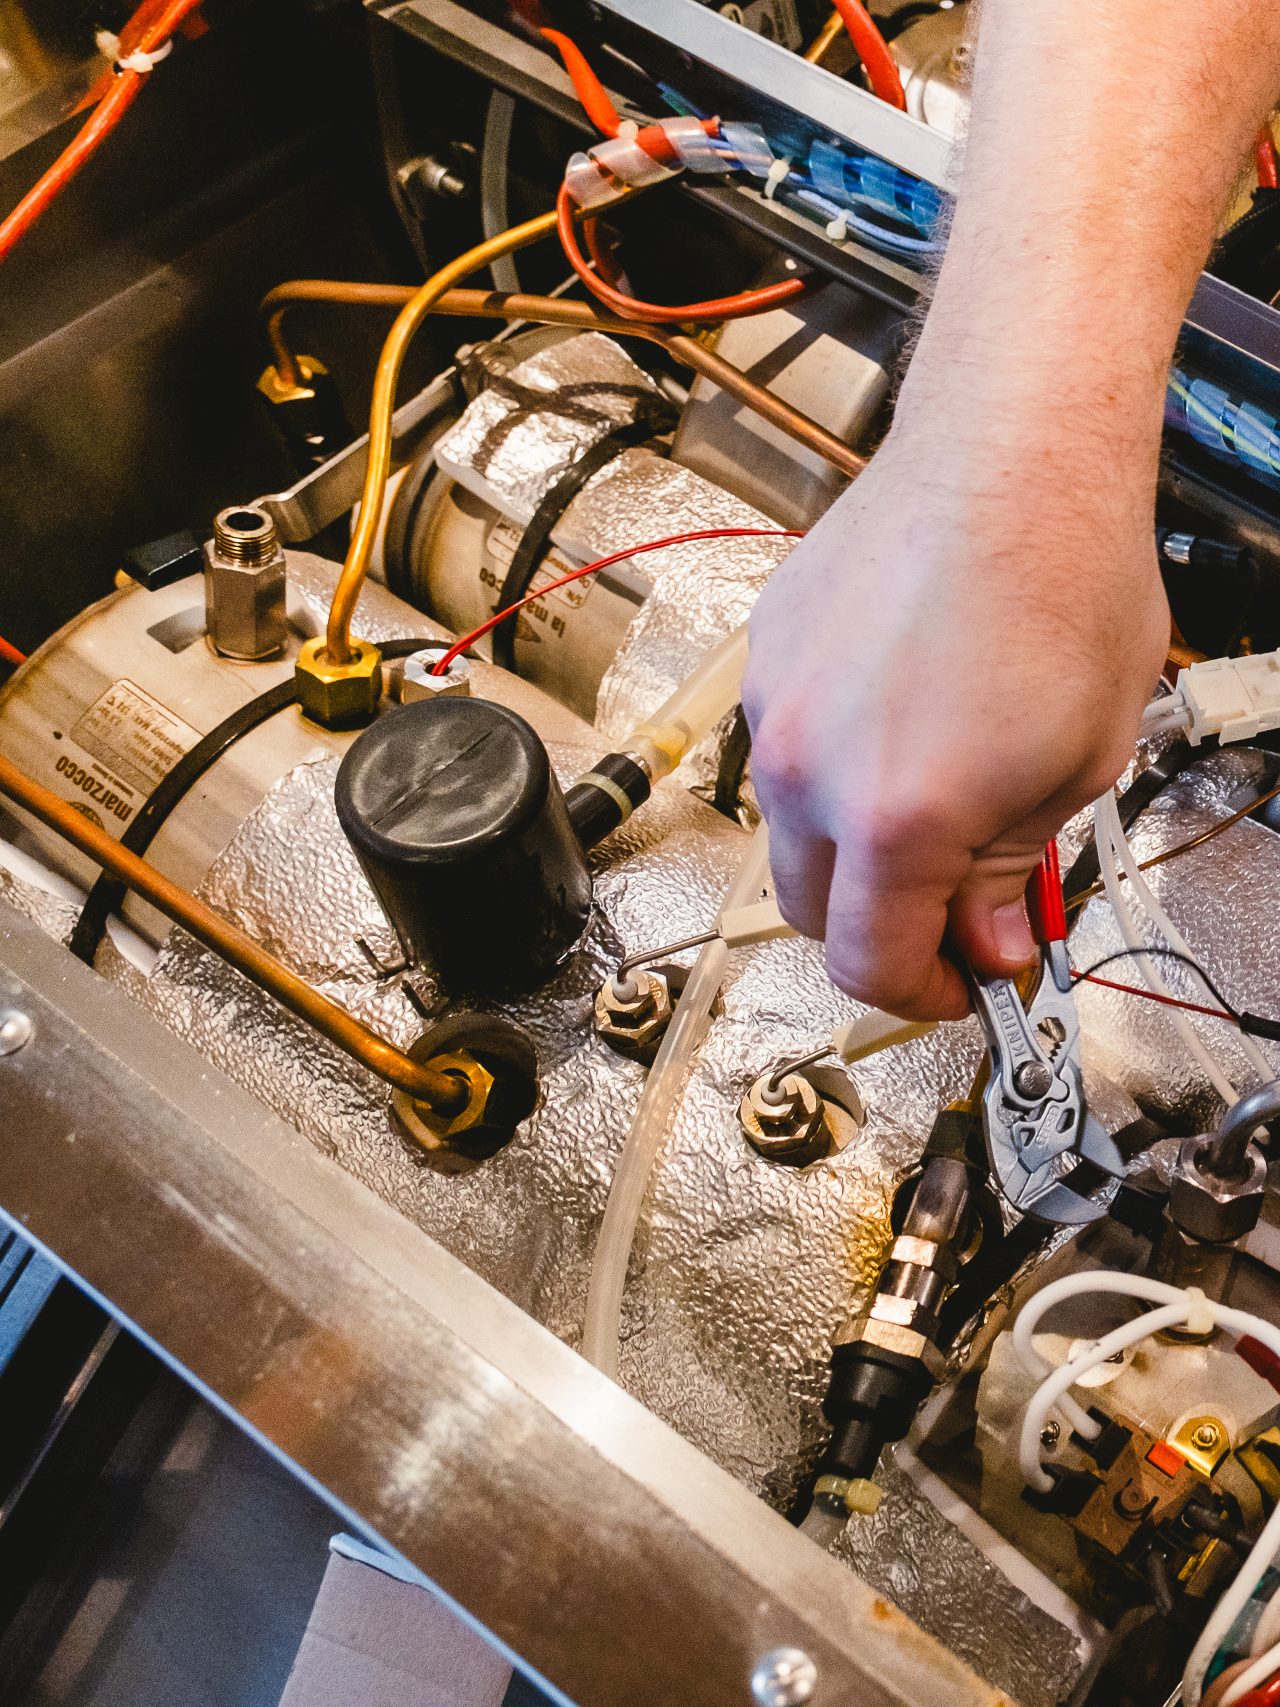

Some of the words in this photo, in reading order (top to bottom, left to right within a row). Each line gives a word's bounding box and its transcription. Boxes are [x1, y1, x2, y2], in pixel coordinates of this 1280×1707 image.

[478, 567, 549, 622] macco
[54, 755, 134, 822] marzocco
[990, 983, 1026, 1057] KNIPEX
